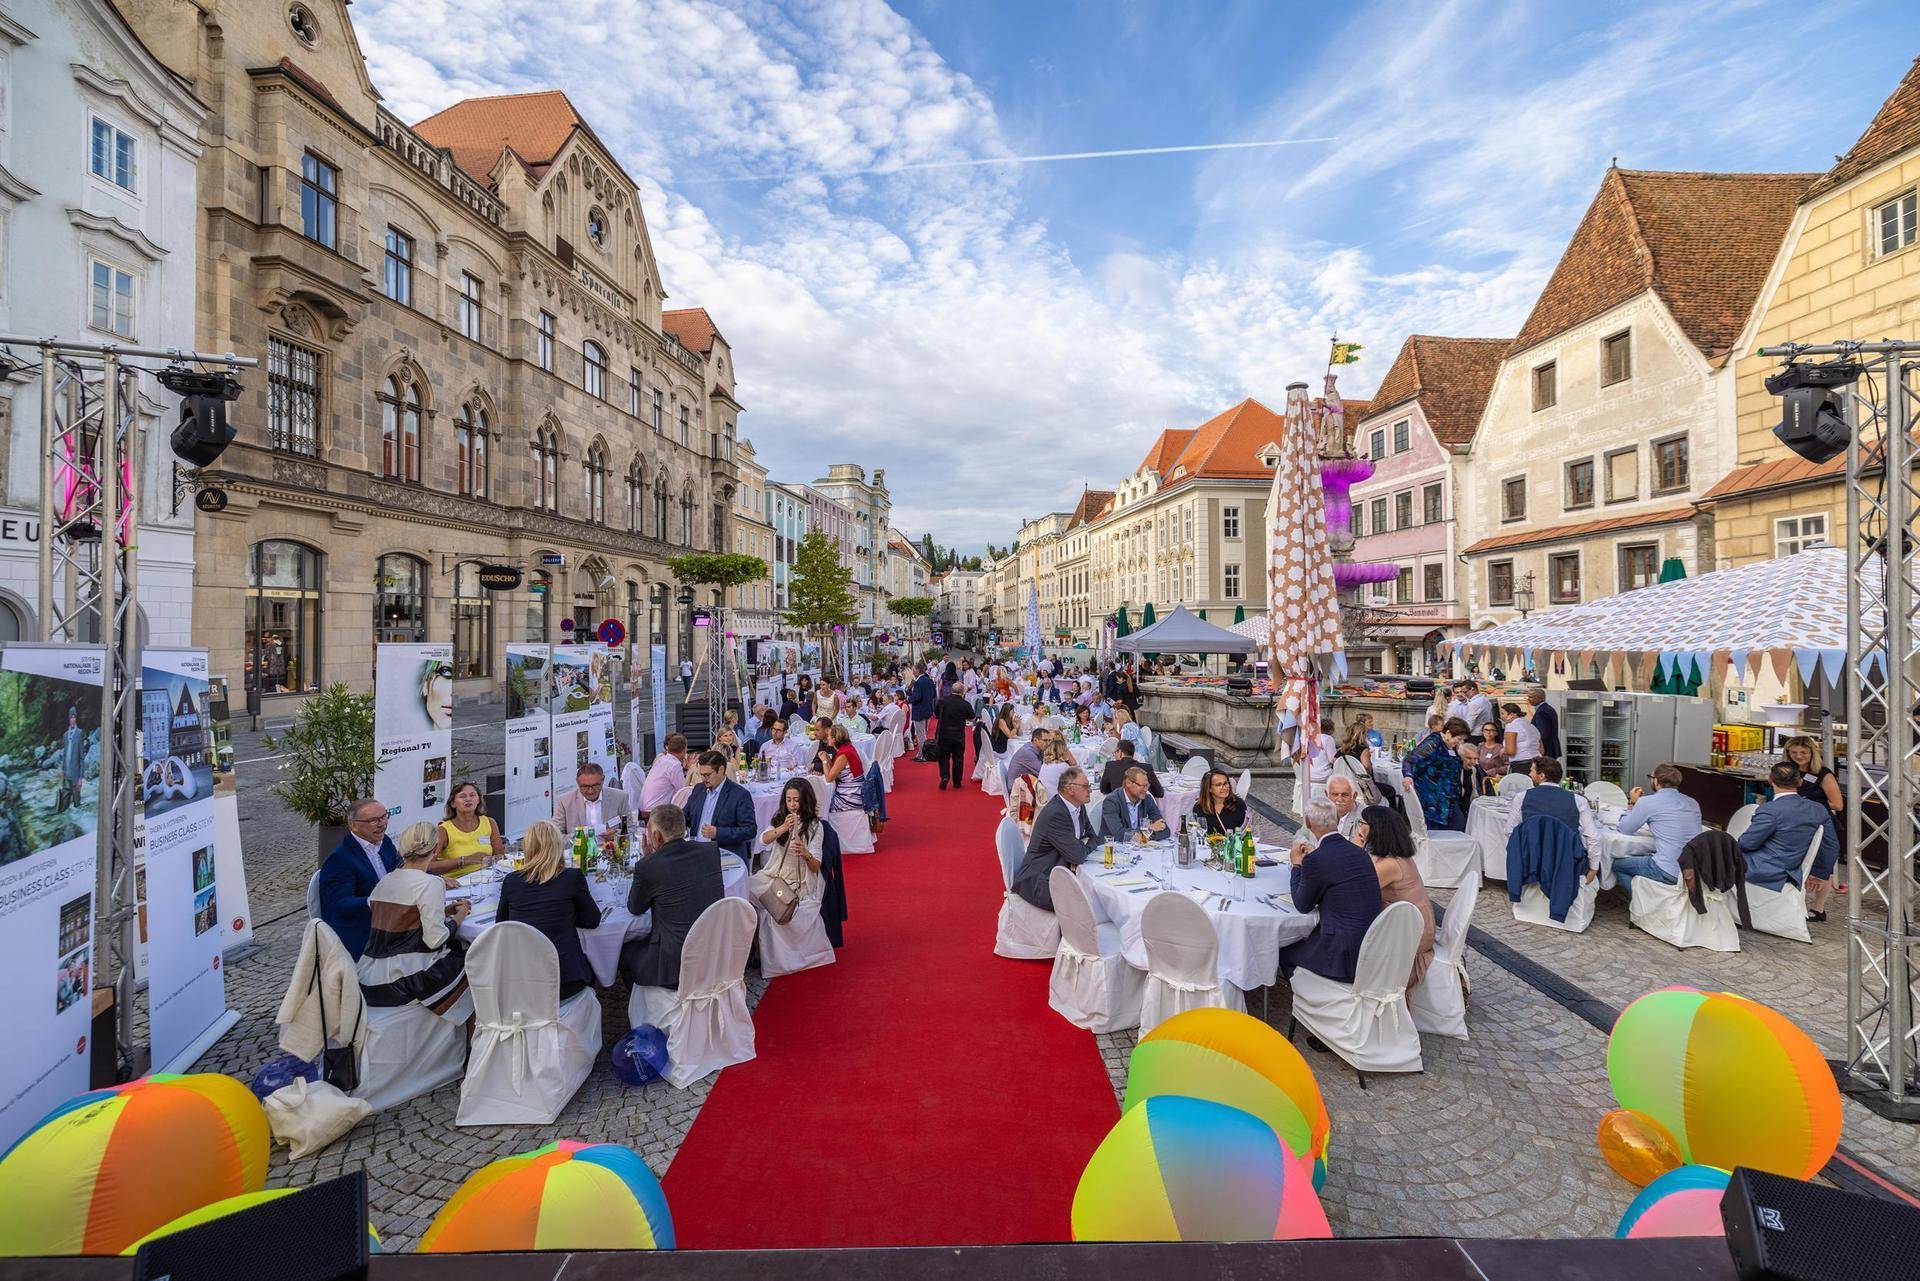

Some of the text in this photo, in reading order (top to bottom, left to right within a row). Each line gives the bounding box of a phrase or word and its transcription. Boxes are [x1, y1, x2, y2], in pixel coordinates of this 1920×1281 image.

[481, 574, 516, 583] EDUSCHO
[380, 743, 420, 756] Regional
[421, 742, 432, 750] TV
[149, 830, 178, 850] BUSINESS
[178, 822, 198, 838] CLASS
[43, 867, 71, 888] CLASS
